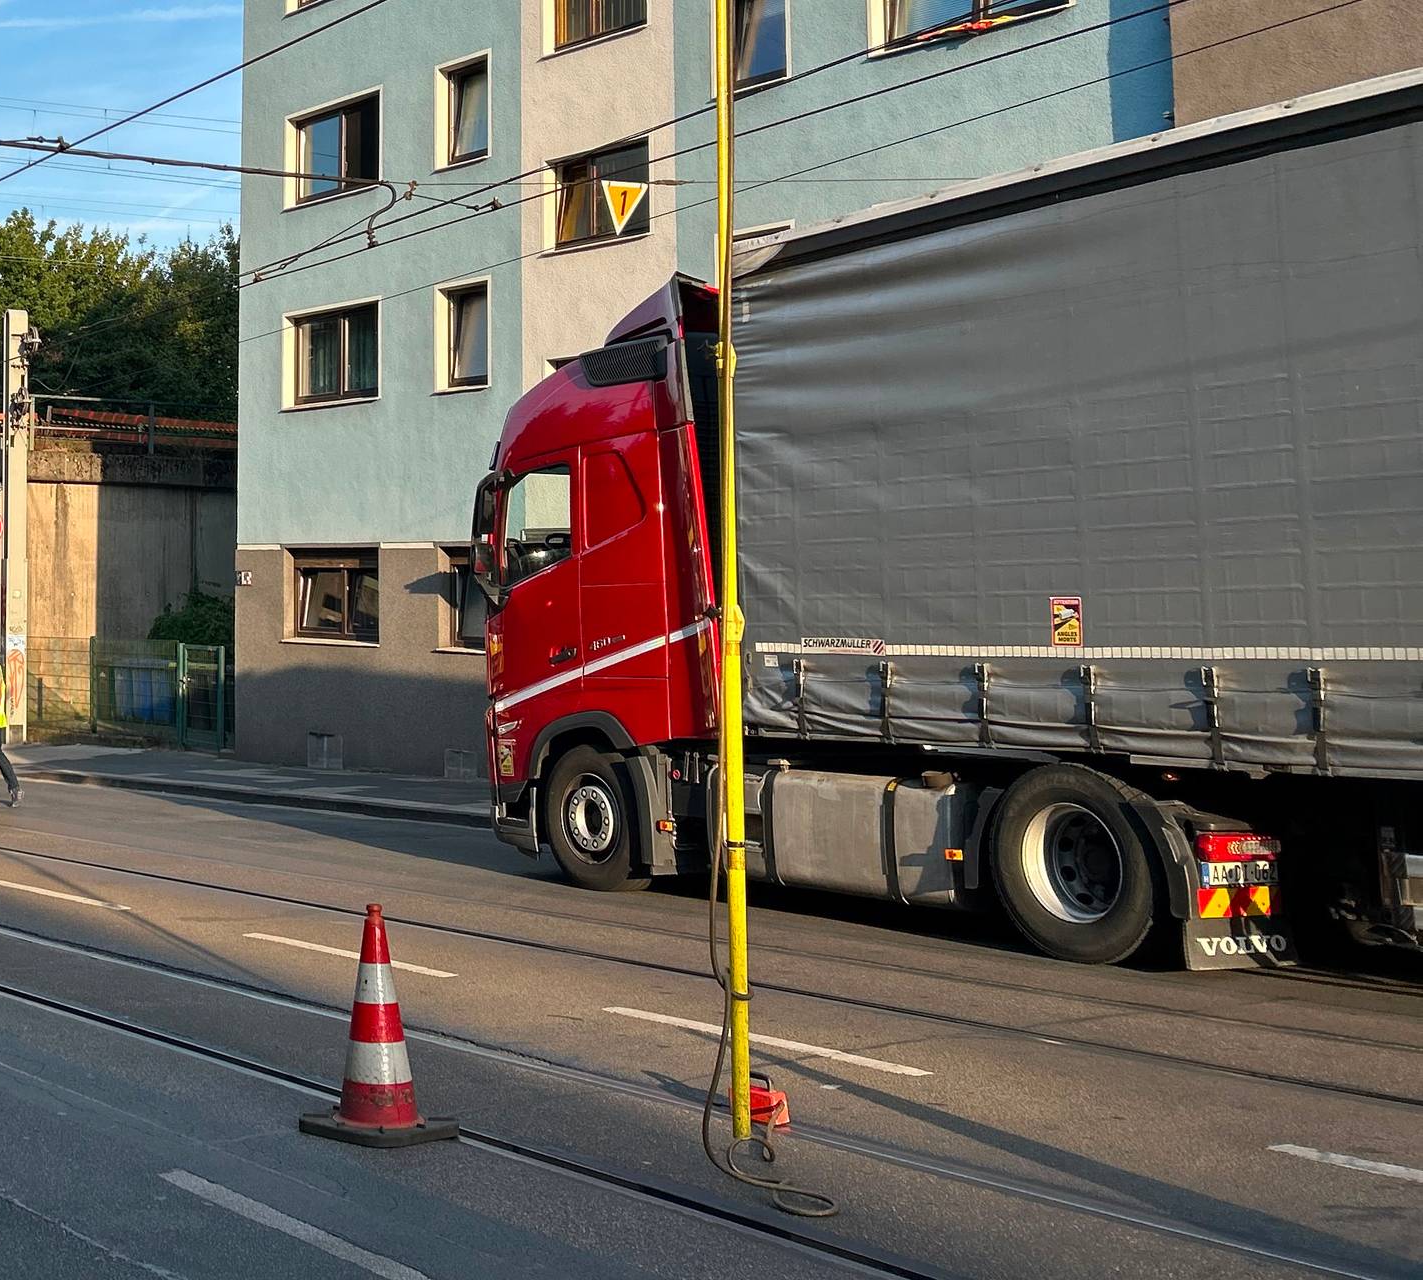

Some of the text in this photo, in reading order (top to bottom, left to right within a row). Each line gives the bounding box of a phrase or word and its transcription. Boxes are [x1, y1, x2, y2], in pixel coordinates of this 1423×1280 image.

[619, 189, 628, 217] 1
[1213, 865, 1228, 883] AA
[1196, 934, 1287, 957] VOLVO
